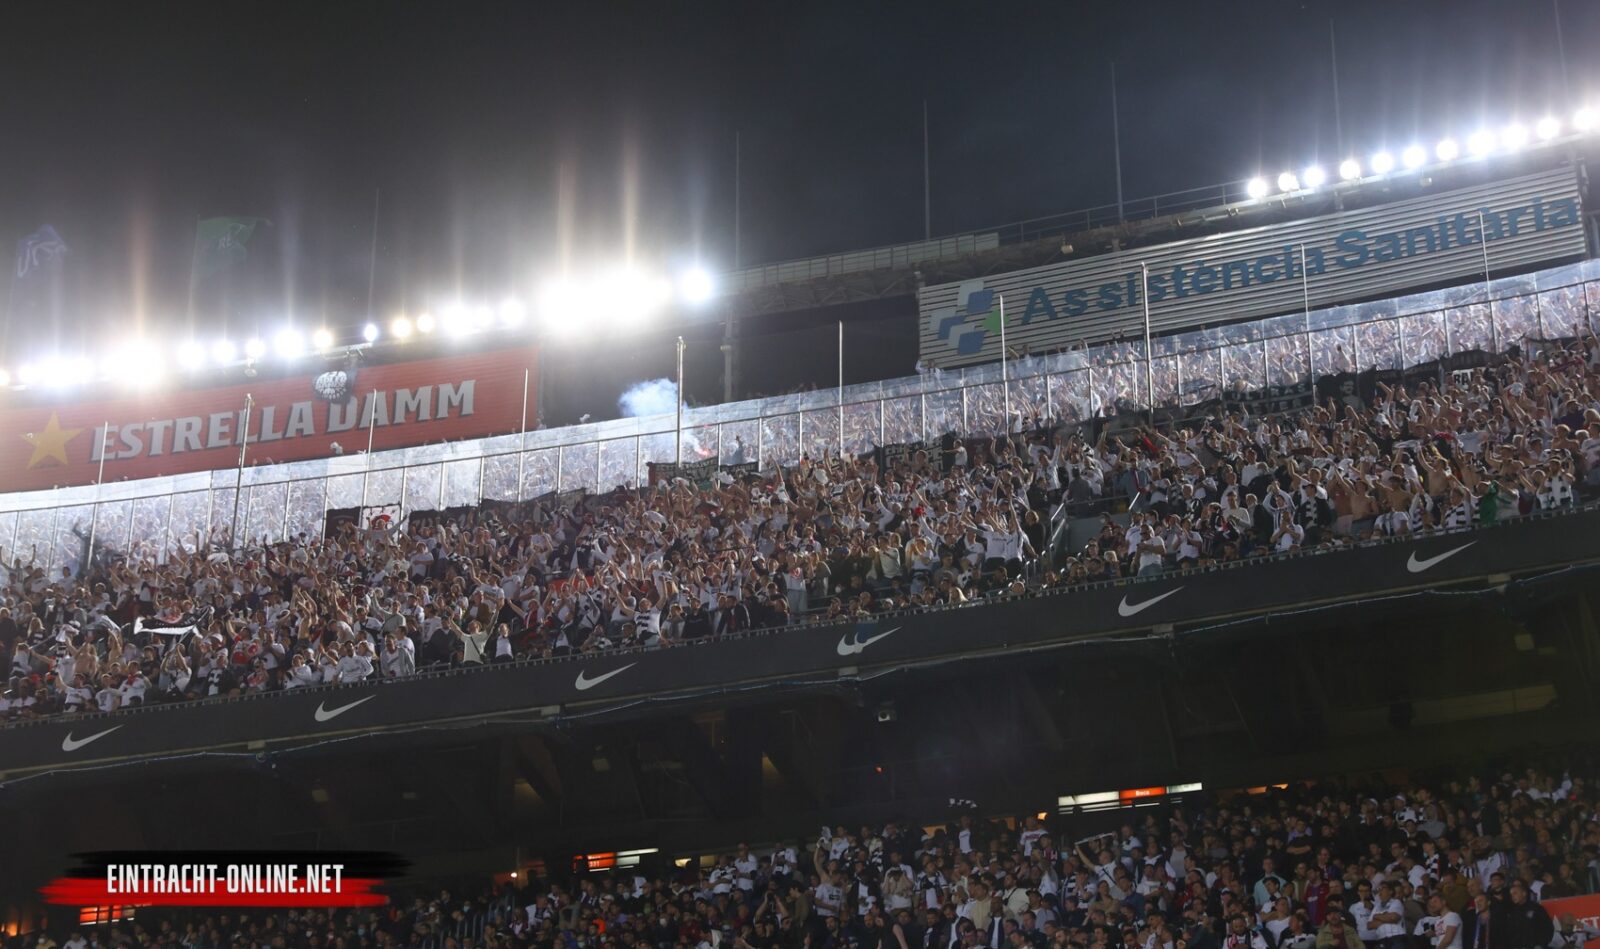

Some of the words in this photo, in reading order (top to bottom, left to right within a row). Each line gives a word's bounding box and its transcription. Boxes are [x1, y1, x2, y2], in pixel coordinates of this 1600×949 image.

[1020, 243, 1326, 325] Assistència
[1335, 197, 1579, 269] Sanitària
[90, 400, 315, 461] ESTRELLA
[327, 380, 476, 433] DAMM
